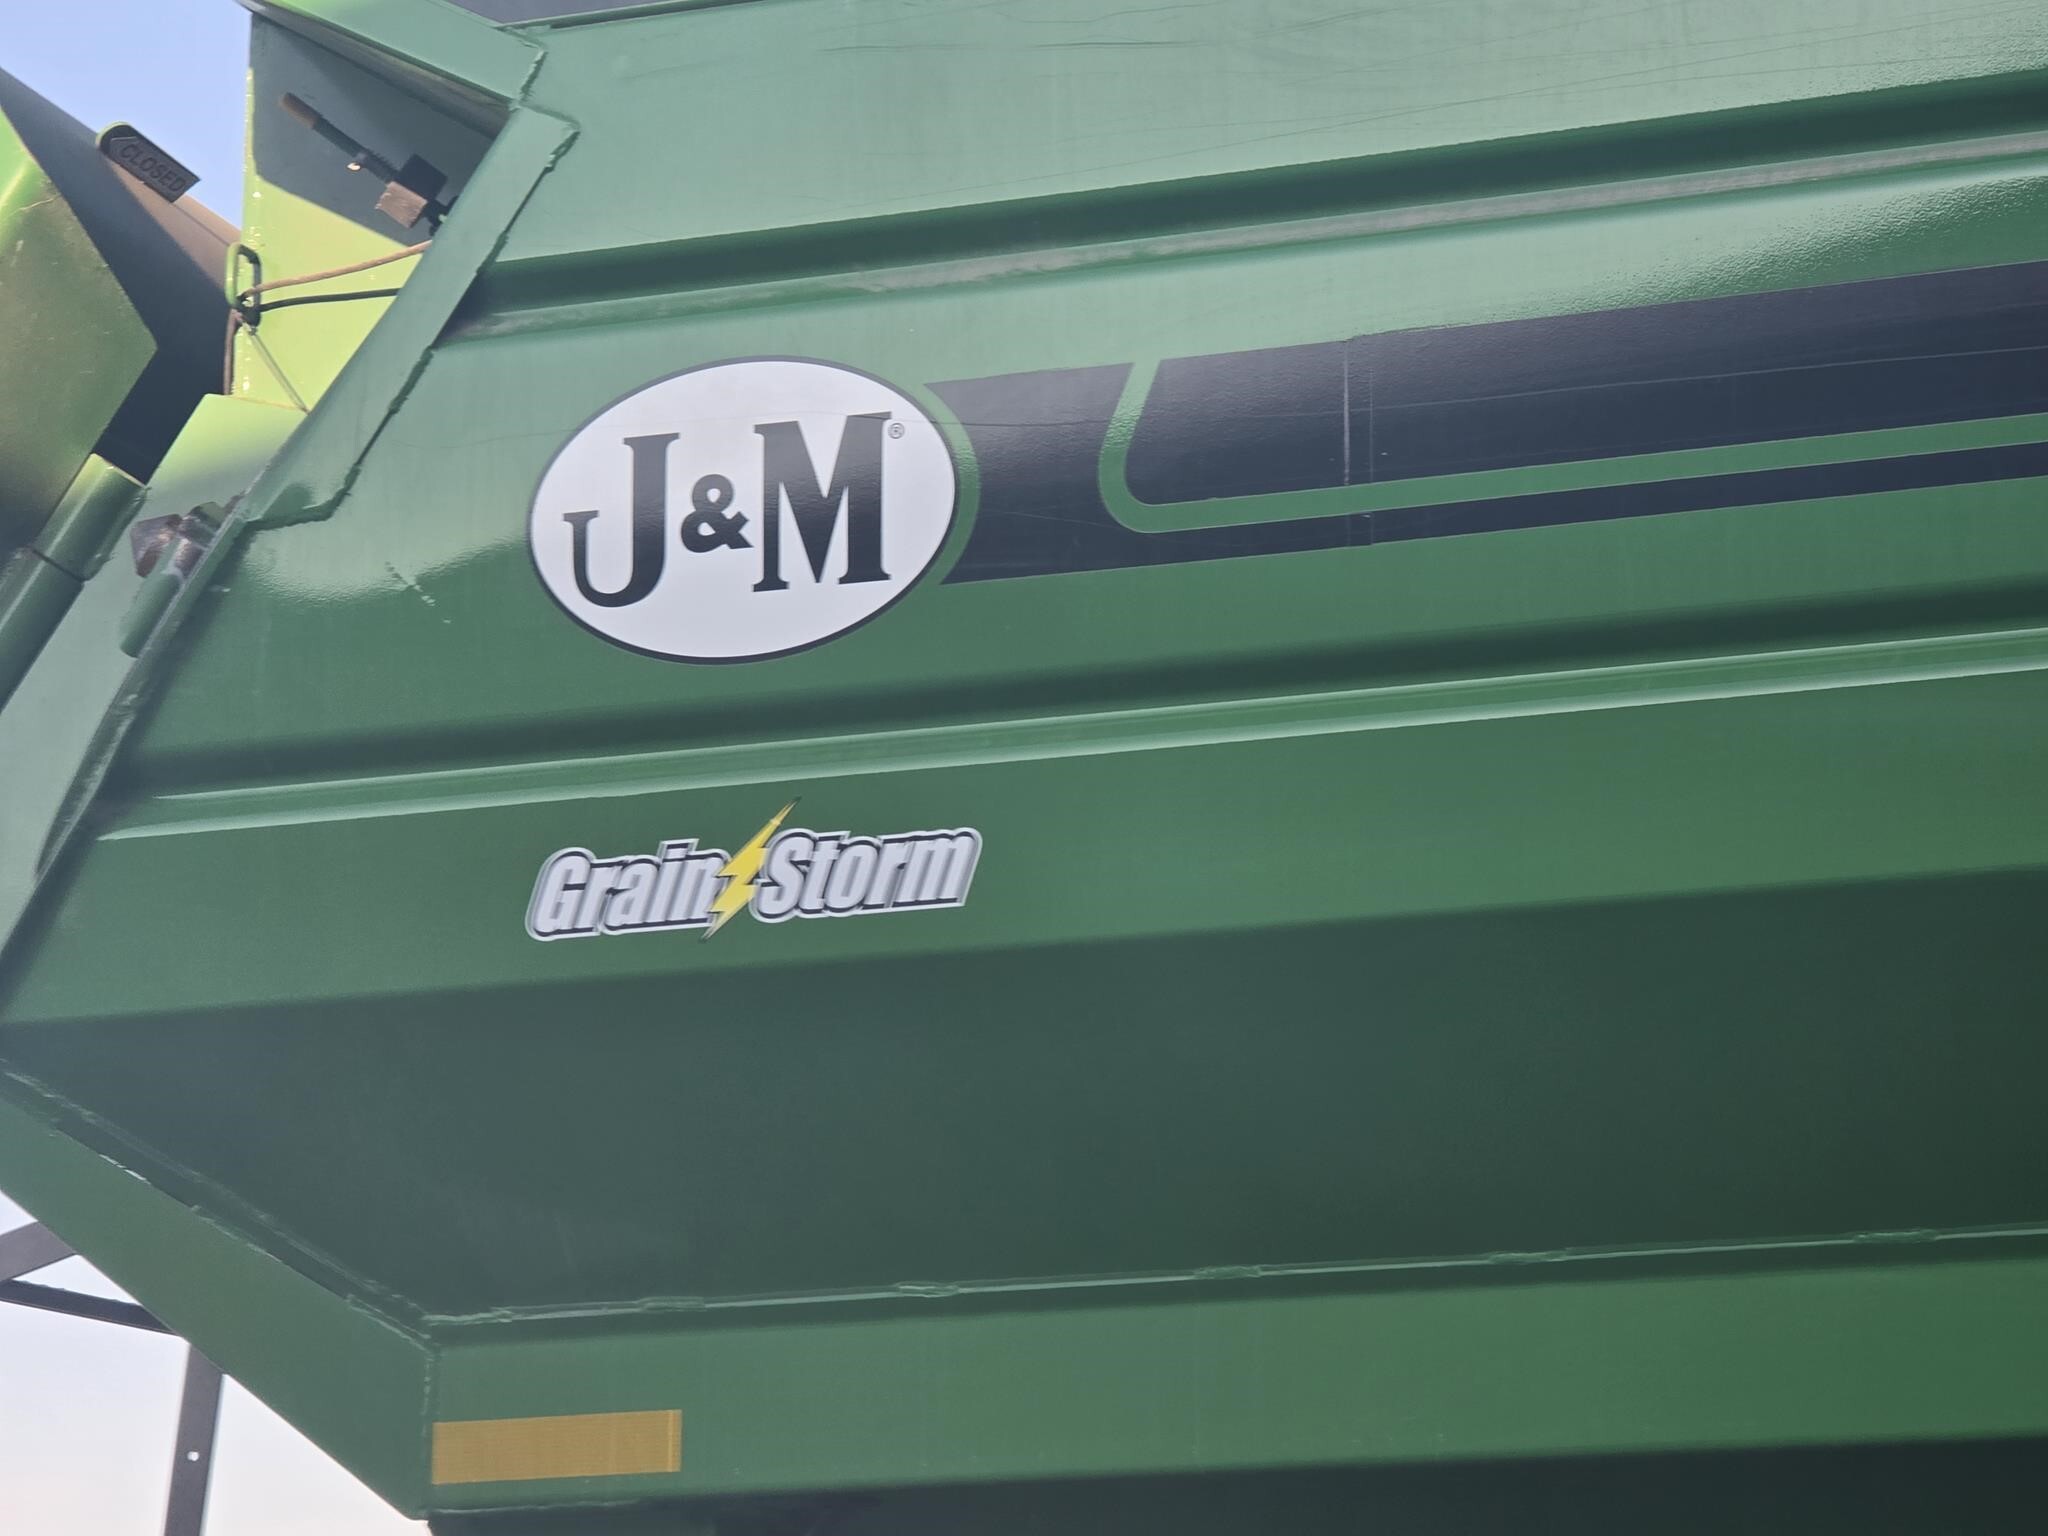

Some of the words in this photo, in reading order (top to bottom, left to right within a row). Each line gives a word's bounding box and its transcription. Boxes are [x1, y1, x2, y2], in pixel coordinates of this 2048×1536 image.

[120, 143, 187, 192] CLOSED
[527, 840, 730, 940] Grain
[750, 828, 981, 922] Storm
